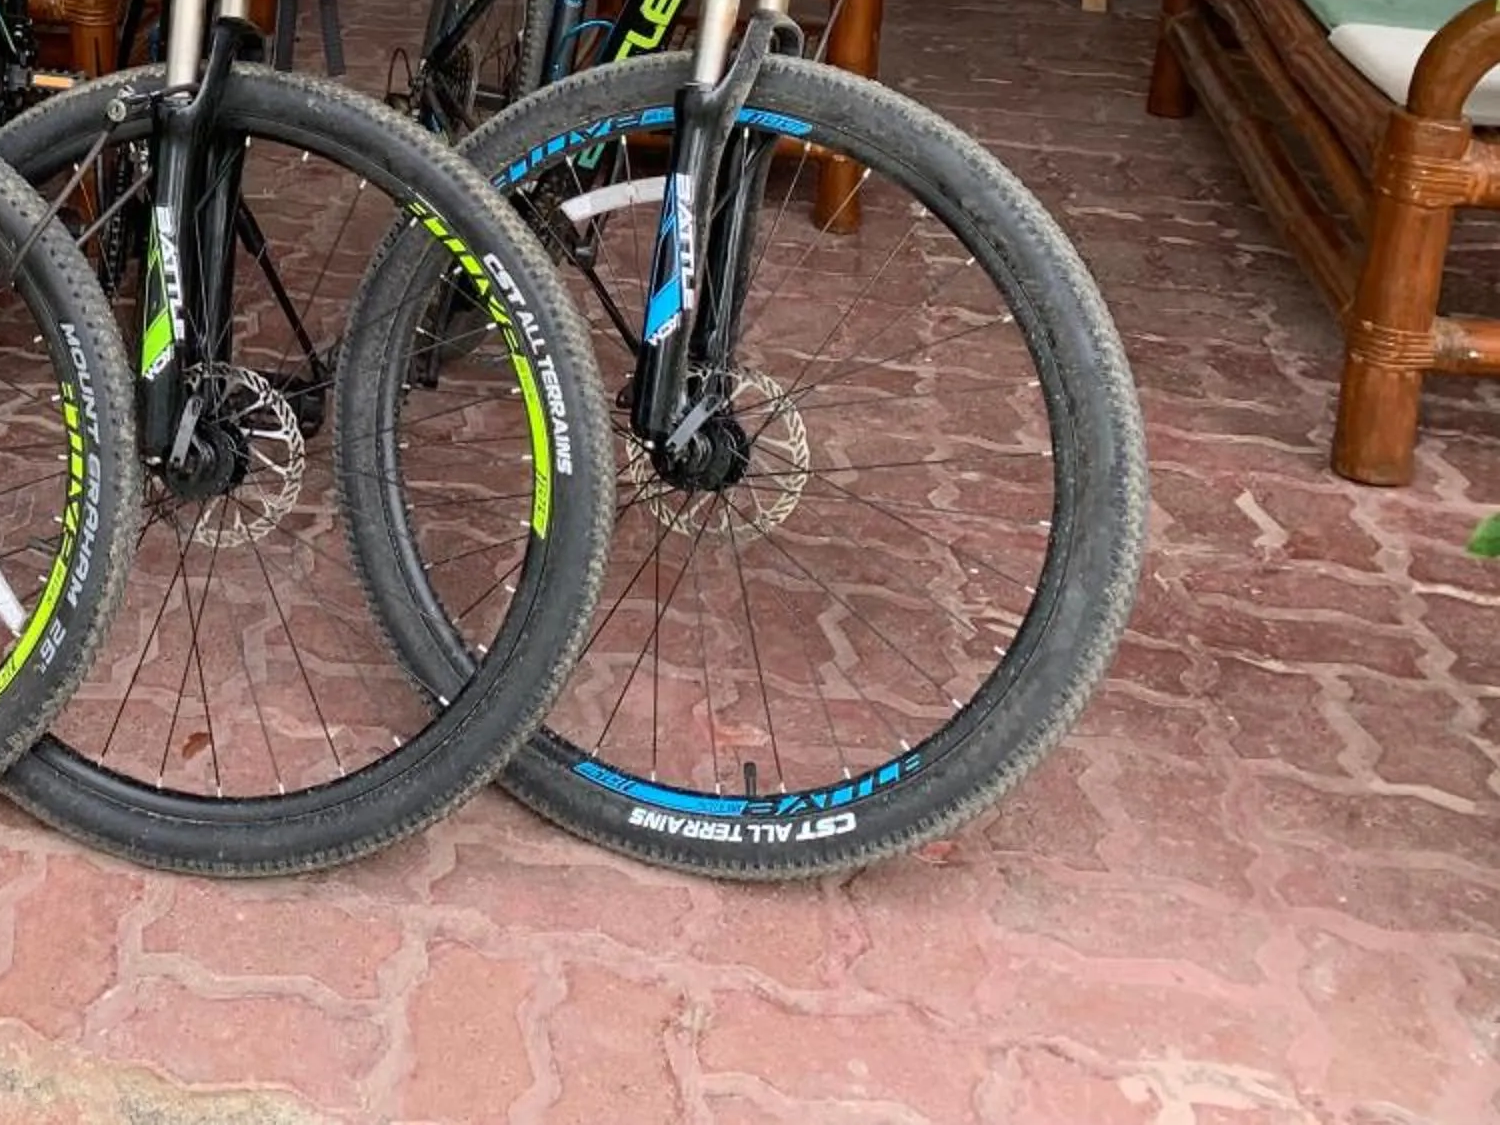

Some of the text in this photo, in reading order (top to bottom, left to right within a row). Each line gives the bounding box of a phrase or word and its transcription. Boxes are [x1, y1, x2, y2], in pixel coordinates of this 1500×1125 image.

[59, 322, 100, 444] MOUNT
[483, 252, 527, 309] CST
[516, 311, 549, 356] ALL
[537, 354, 573, 477] TERRAINS
[67, 450, 101, 609] GRAHAM
[628, 808, 743, 843] TERRAINS
[748, 823, 790, 844] ALL
[796, 812, 857, 841] CST
